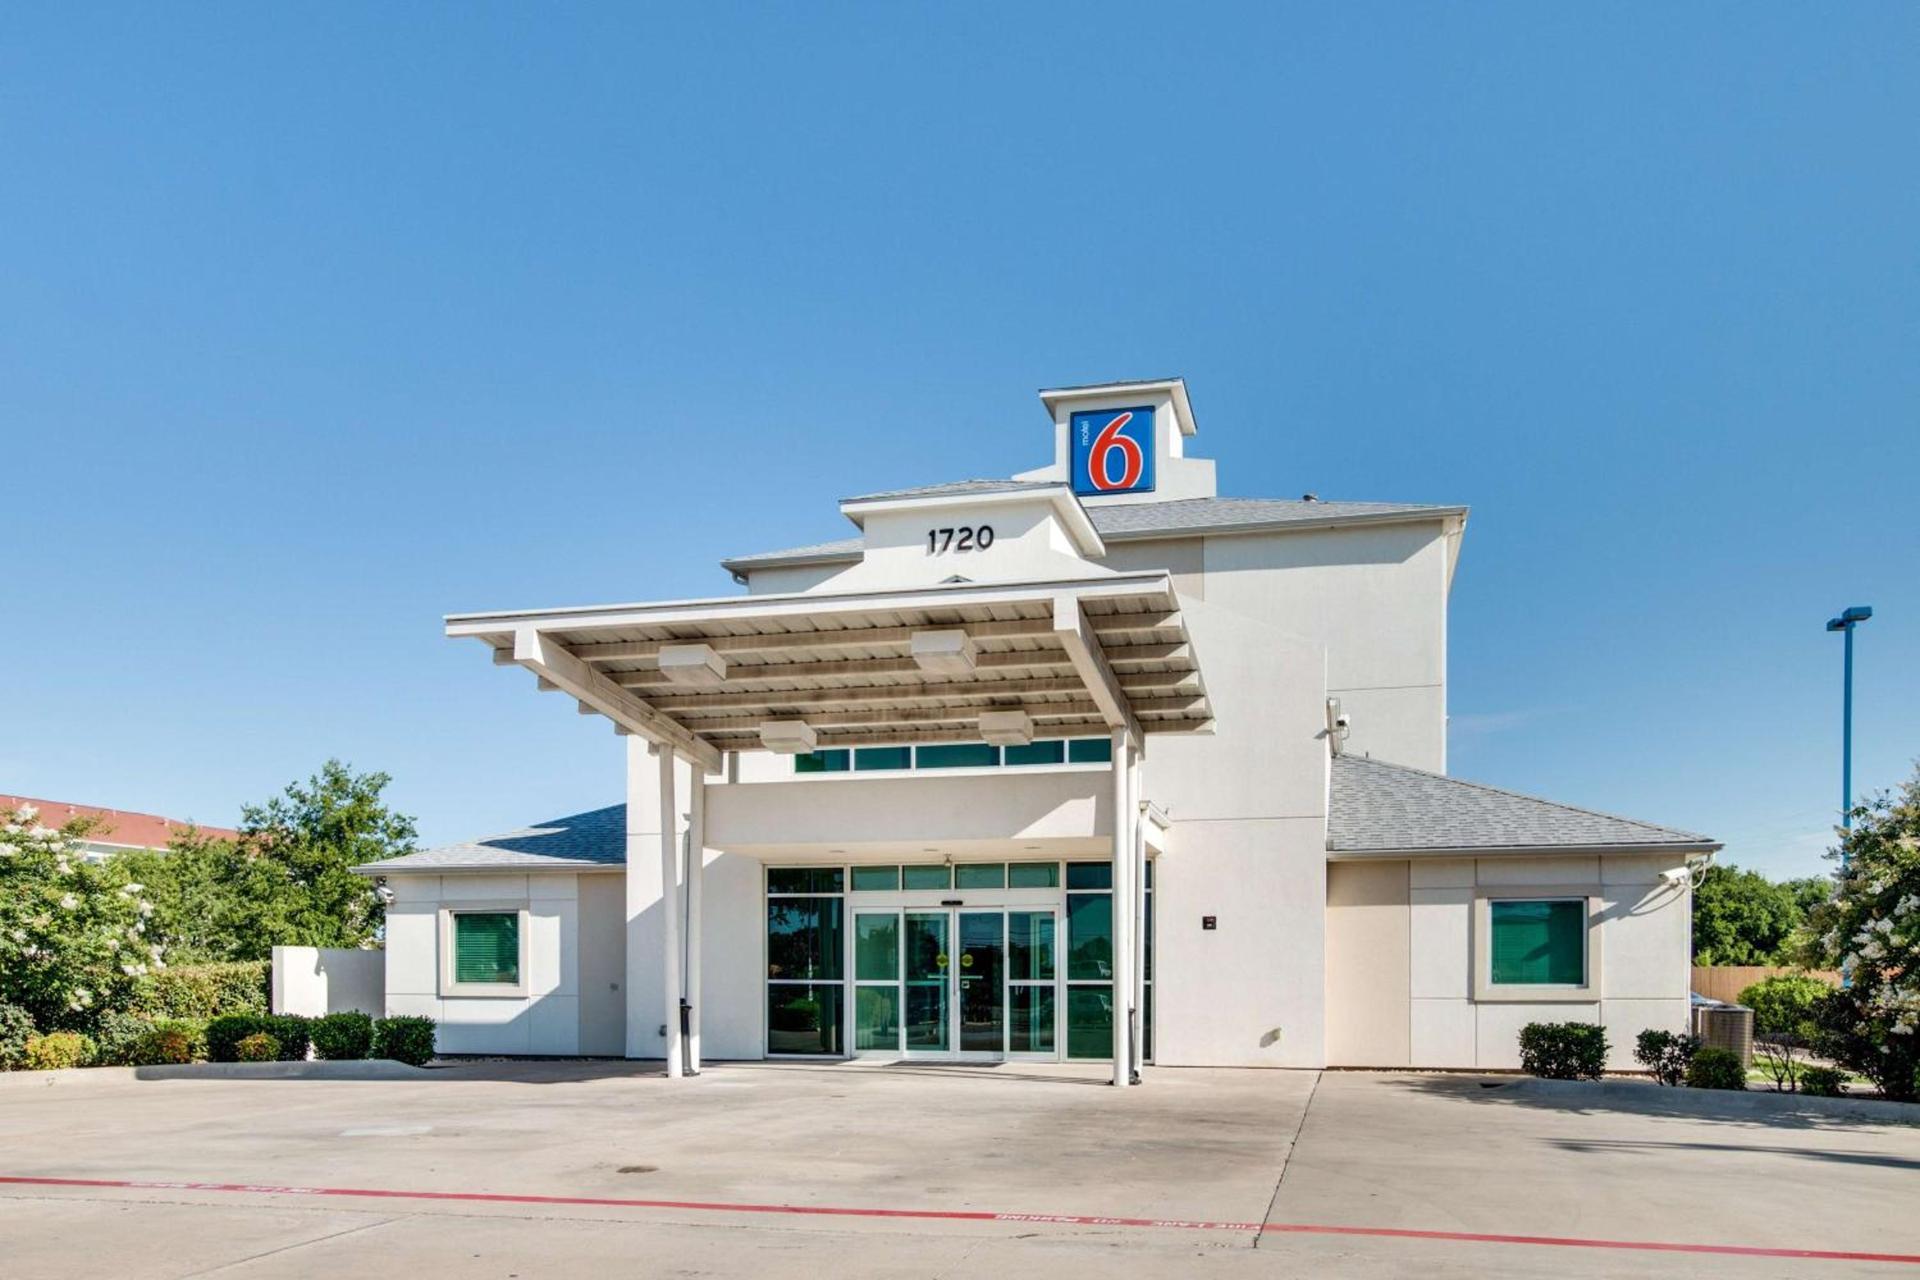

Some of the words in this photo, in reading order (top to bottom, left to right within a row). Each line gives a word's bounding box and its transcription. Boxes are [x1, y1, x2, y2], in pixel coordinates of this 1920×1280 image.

[1081, 420, 1089, 447] motel
[1088, 411, 1143, 490] 6
[928, 525, 994, 553] 1720
